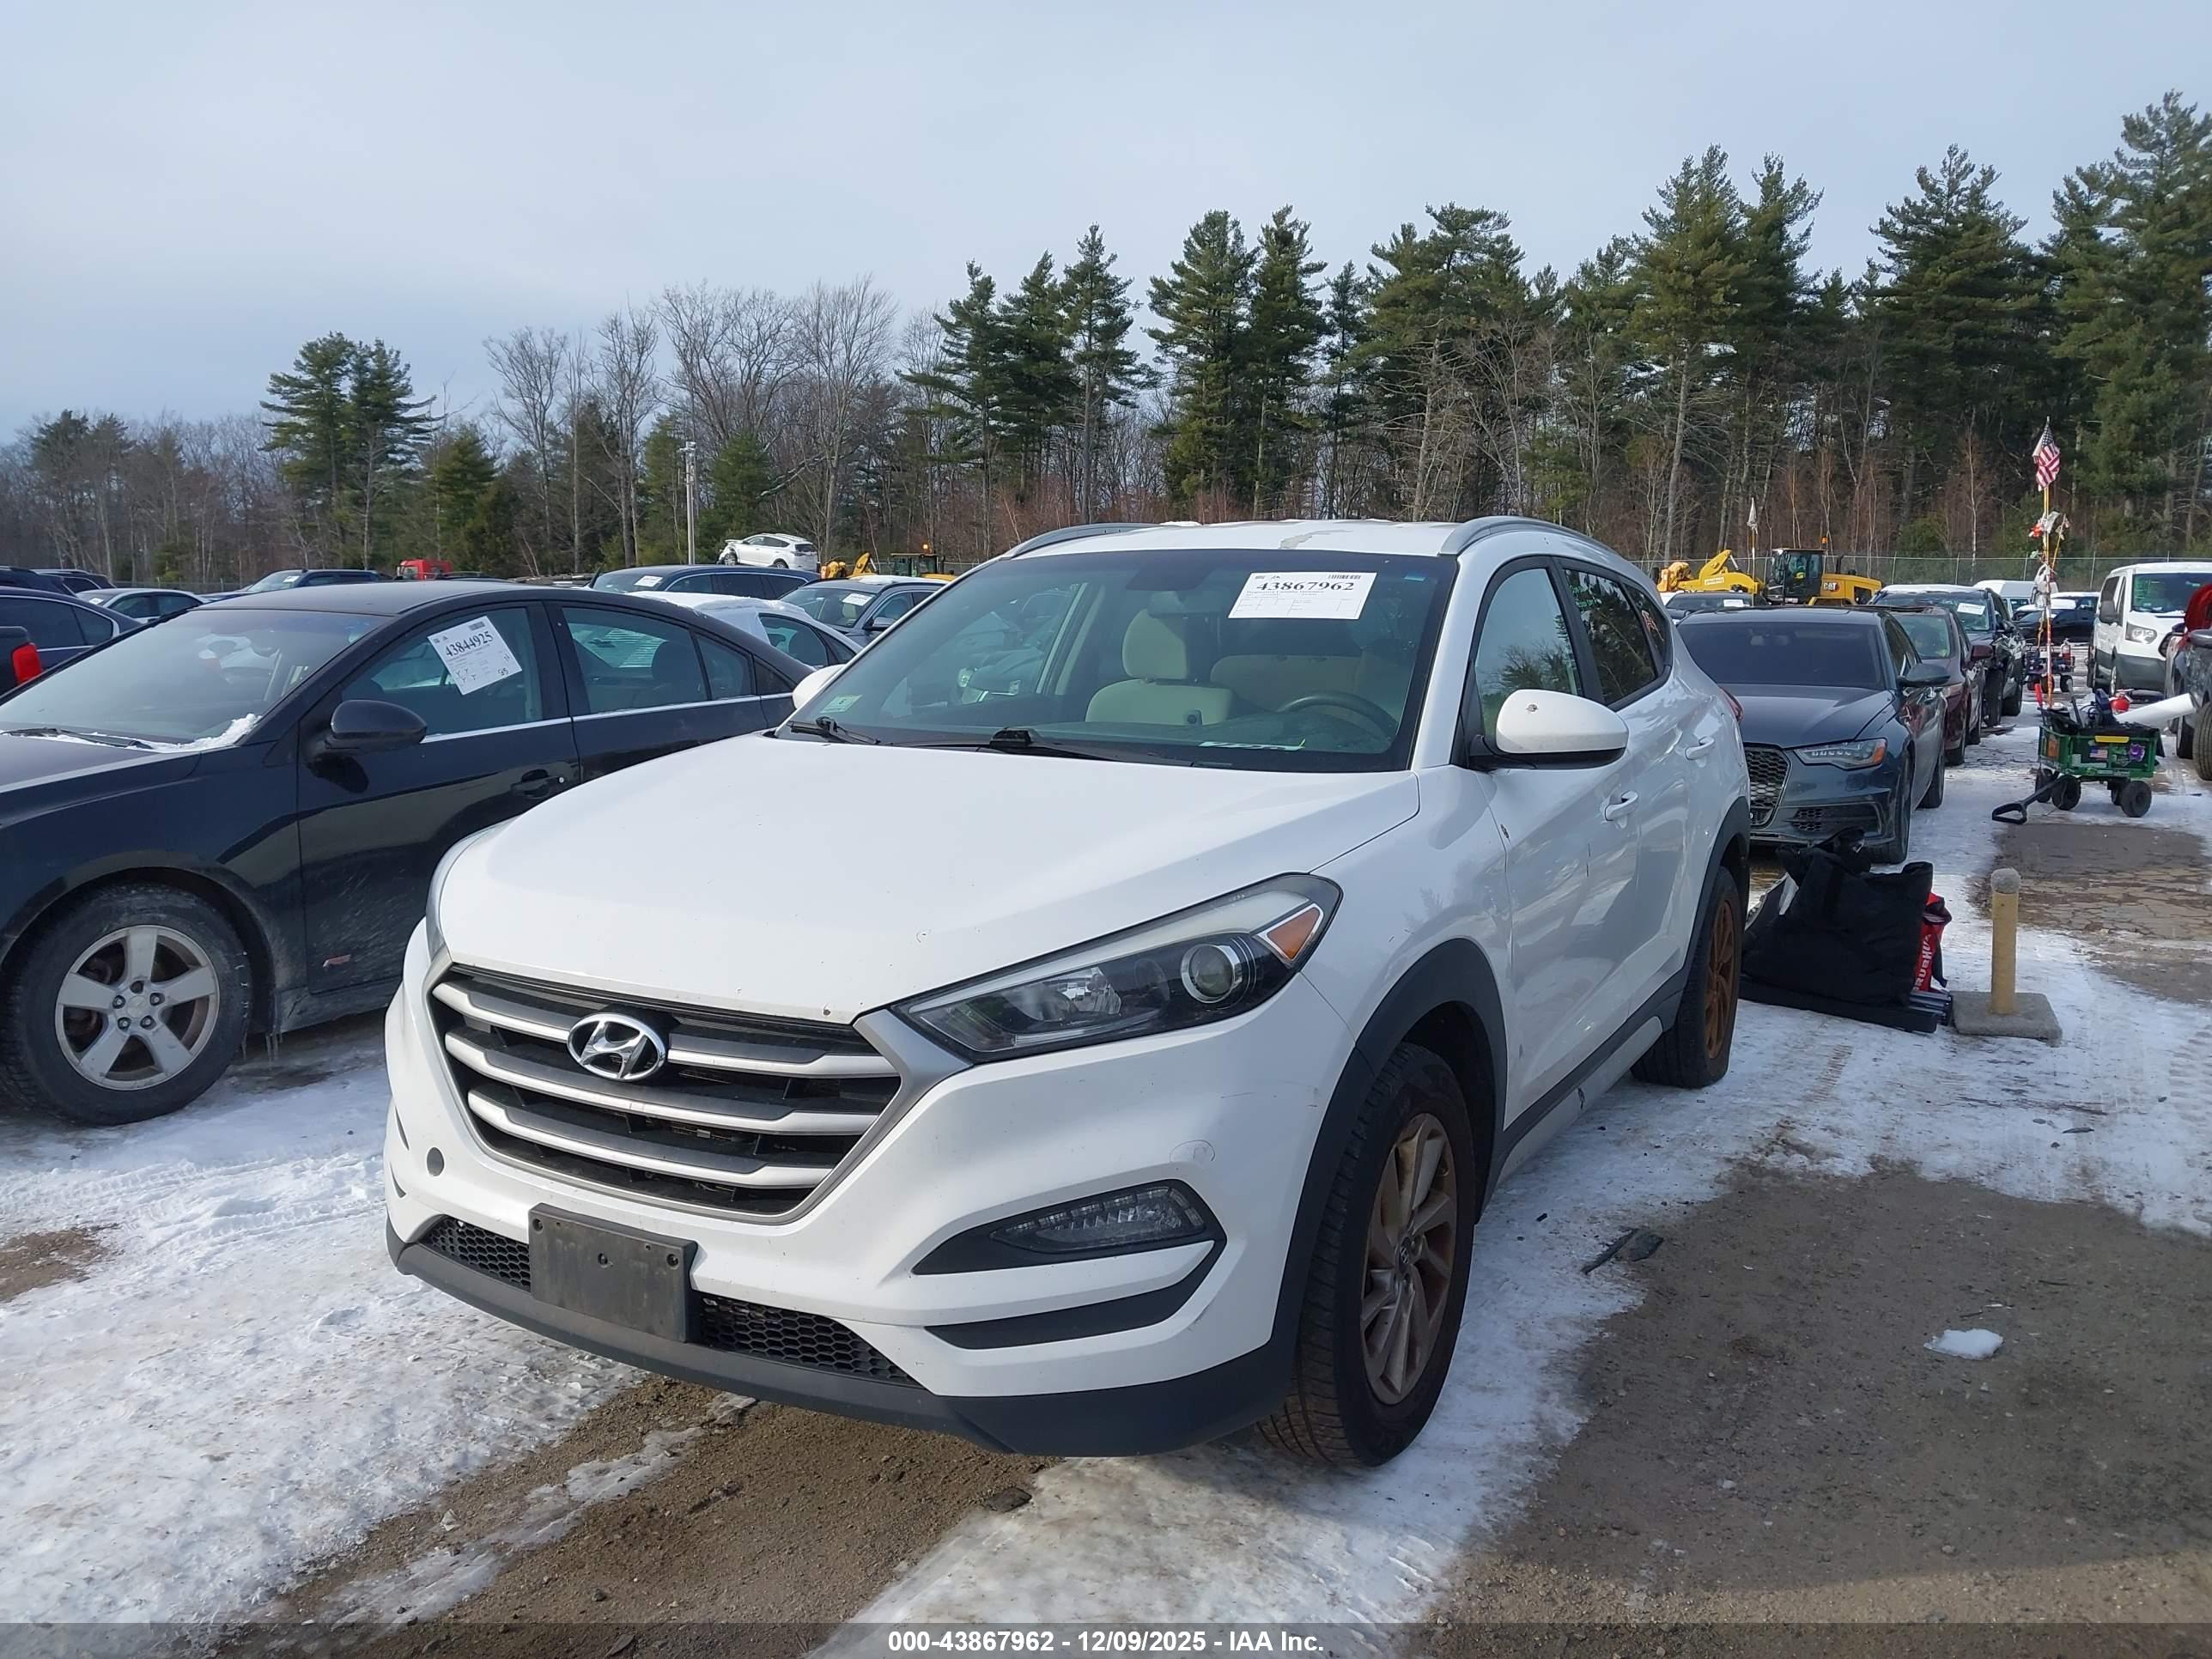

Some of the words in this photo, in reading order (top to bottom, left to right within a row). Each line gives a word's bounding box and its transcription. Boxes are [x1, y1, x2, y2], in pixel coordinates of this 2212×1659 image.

[1256, 581, 1354, 591] 43867962
[1823, 582, 1837, 591] CAT
[446, 630, 494, 657] 43844925
